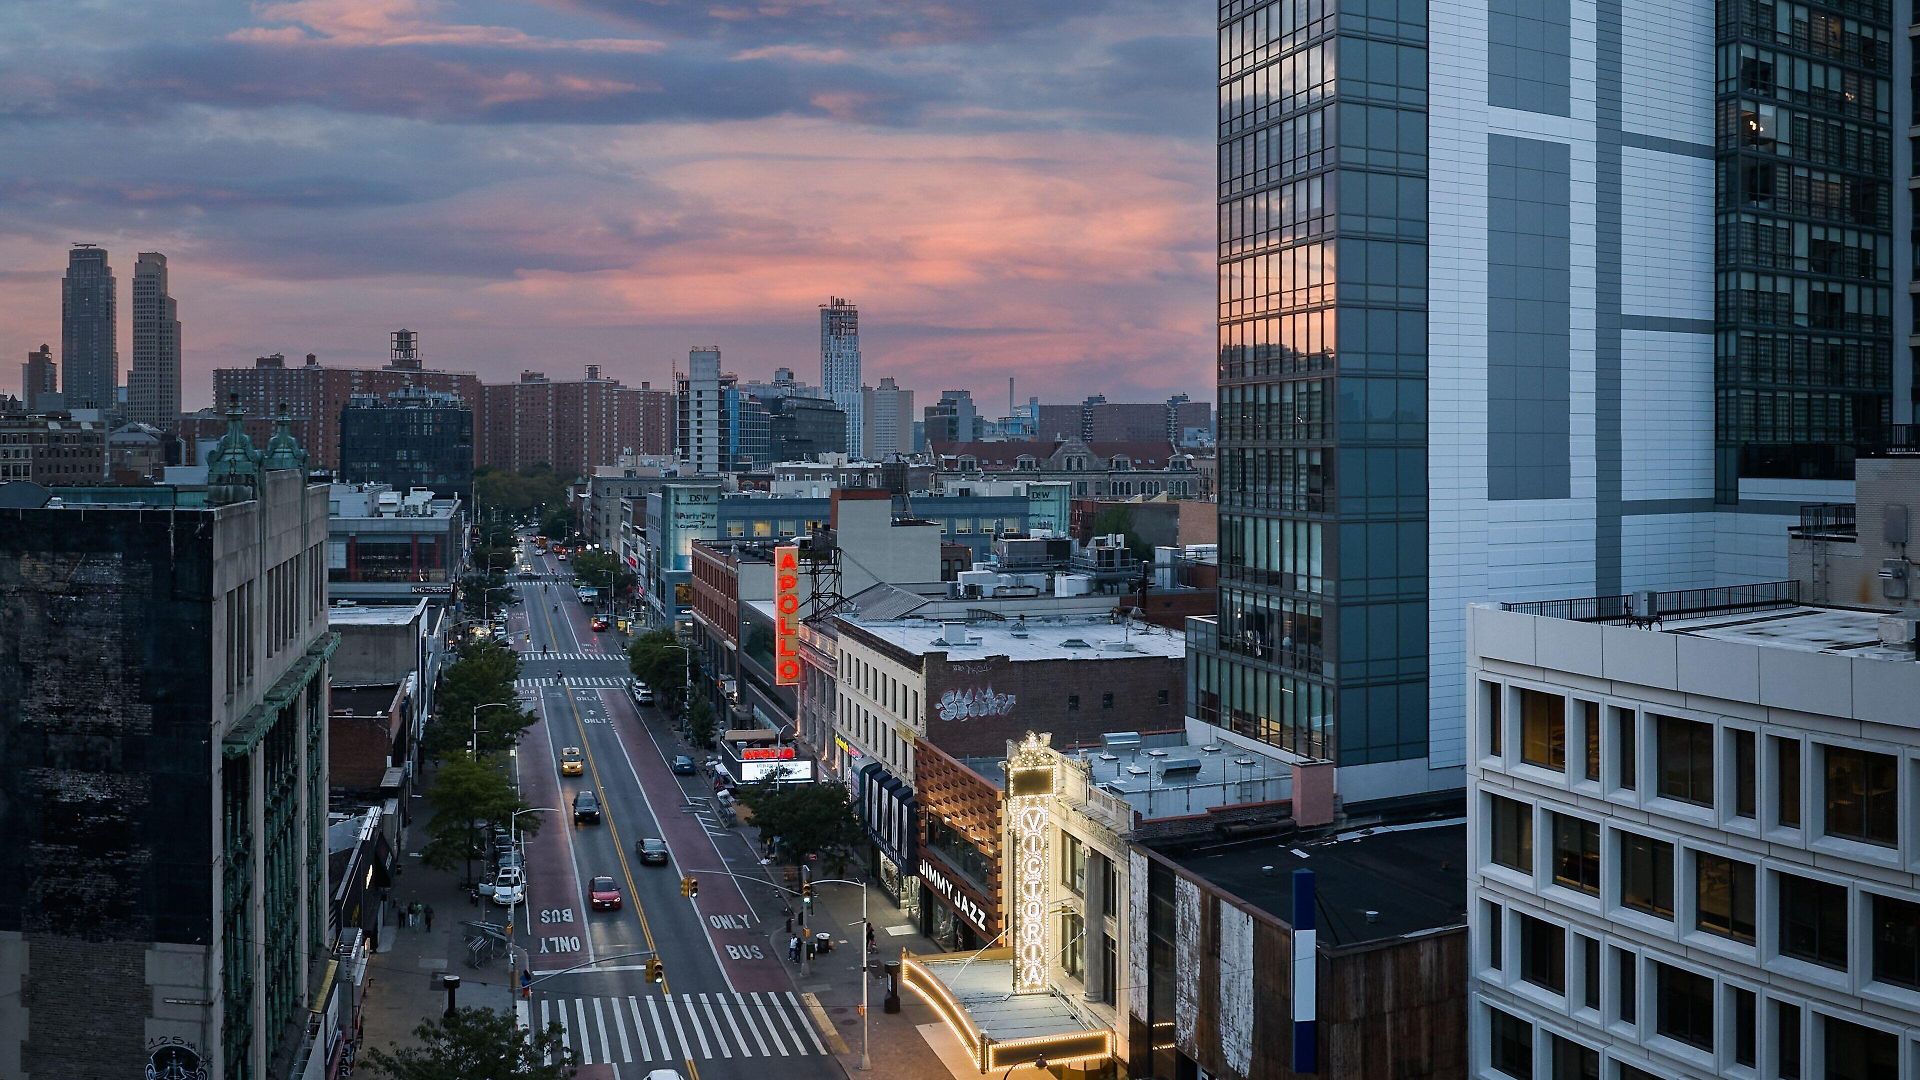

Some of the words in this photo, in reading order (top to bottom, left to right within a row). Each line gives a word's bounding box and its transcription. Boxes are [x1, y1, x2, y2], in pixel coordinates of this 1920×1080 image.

[779, 553, 800, 680] APOLLO
[743, 749, 794, 760] APOLLO
[919, 859, 953, 900] JIMMY
[954, 890, 986, 932] JAZZ
[540, 908, 574, 923] BUS
[709, 914, 751, 930] ONLY
[540, 936, 581, 954] ONLY
[725, 943, 764, 960] BUS
